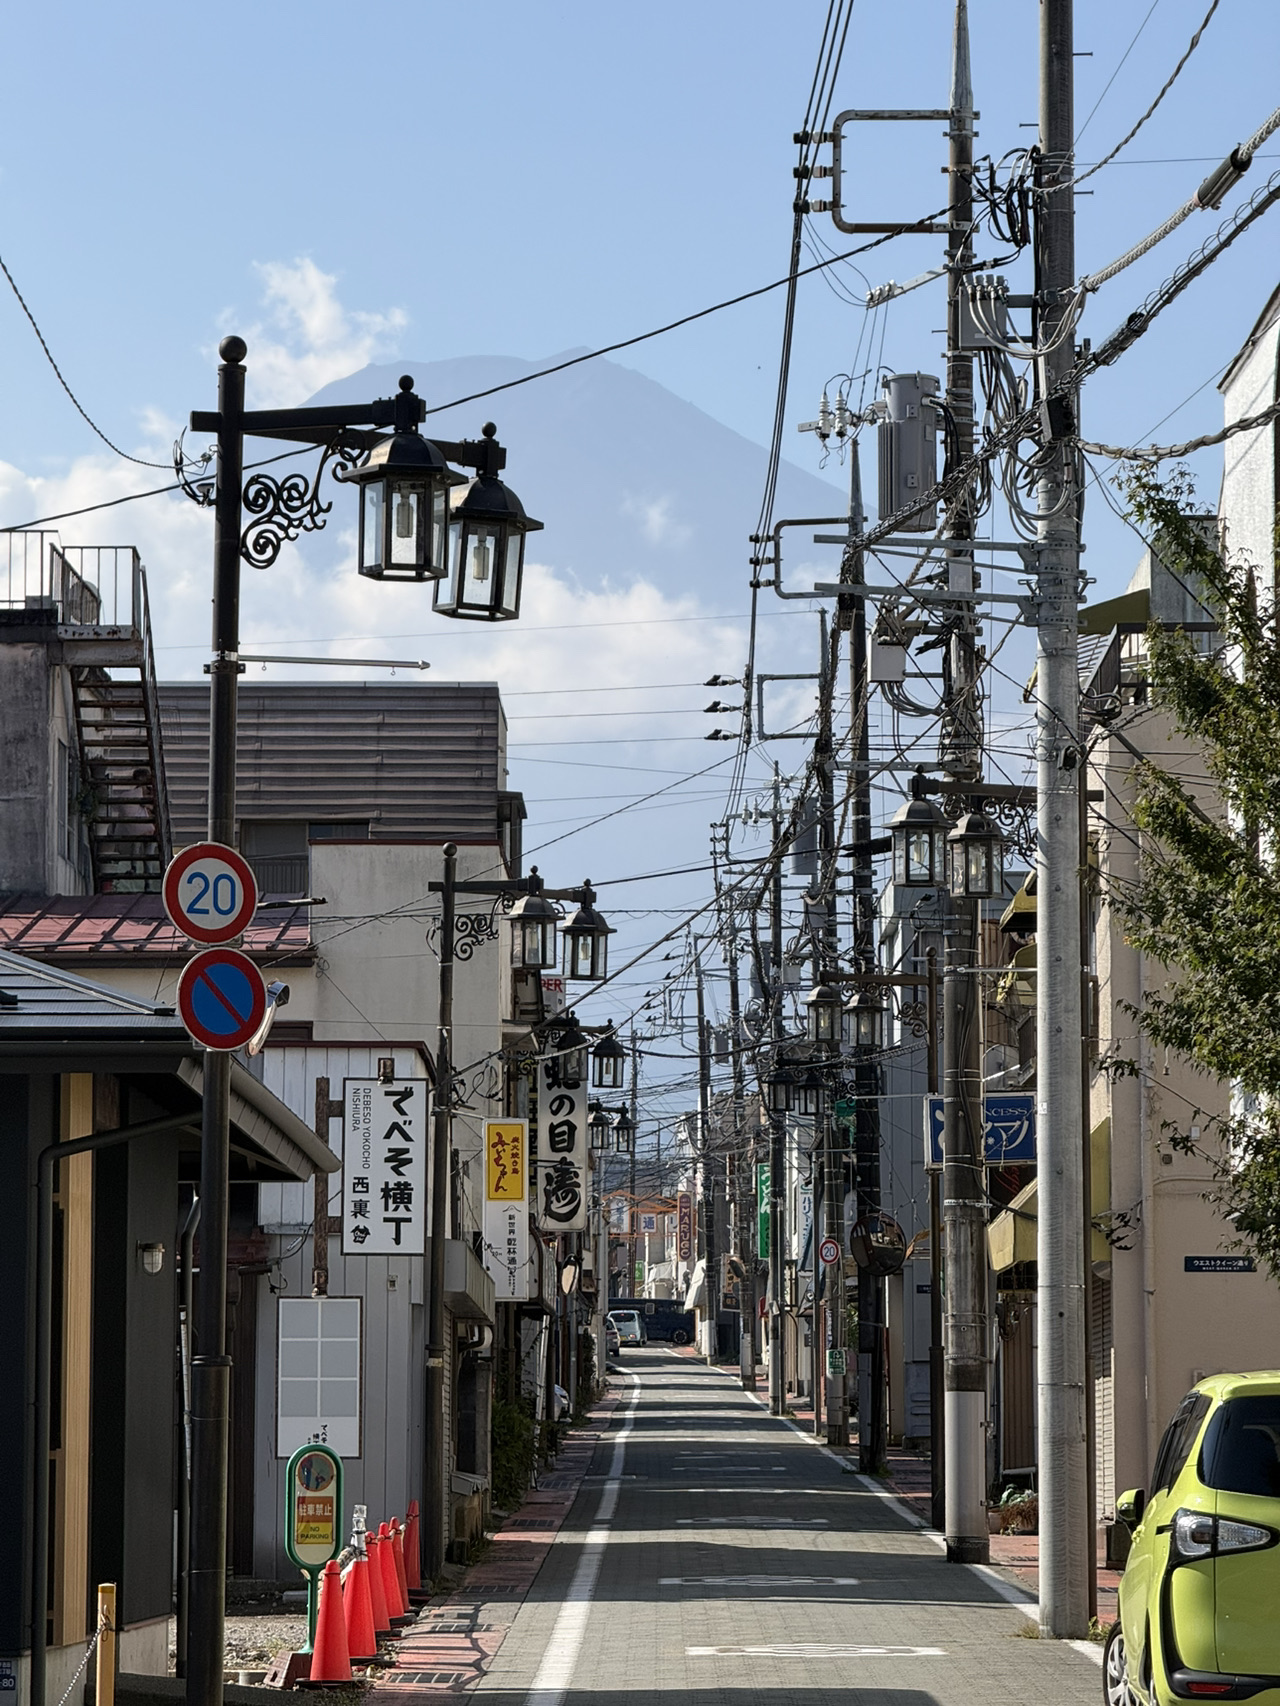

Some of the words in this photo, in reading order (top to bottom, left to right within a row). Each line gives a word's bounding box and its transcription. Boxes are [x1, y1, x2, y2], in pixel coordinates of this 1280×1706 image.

[186, 871, 236, 916] 20
[351, 1087, 361, 1132] NISHIURA
[362, 1087, 372, 1125] DEBESO
[362, 1126, 372, 1170] YOKOCHO
[380, 1086, 415, 1246] でべそ横丁
[350, 1176, 371, 1220] 西裏
[823, 1246, 835, 1257] 20
[298, 1503, 332, 1516] 駐車禁止
